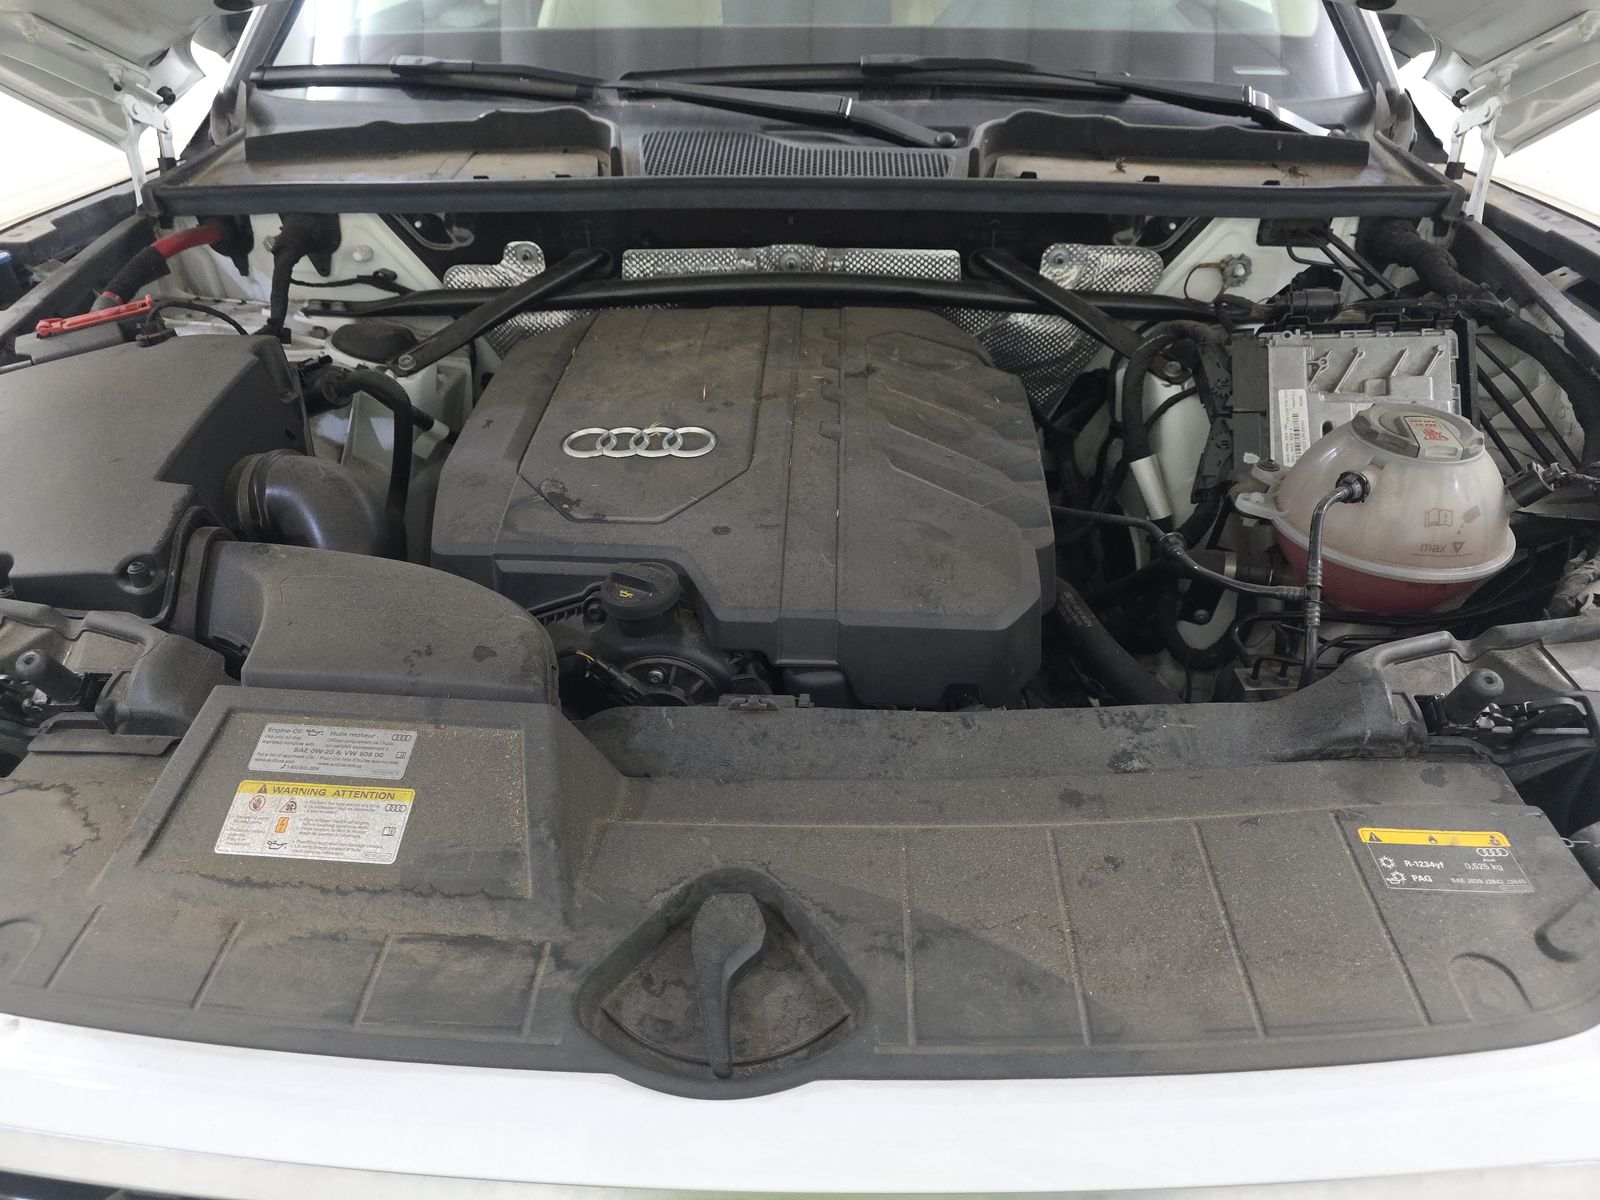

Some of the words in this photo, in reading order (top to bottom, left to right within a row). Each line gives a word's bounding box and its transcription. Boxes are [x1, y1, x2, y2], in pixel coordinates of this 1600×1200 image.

[1420, 544, 1447, 552] max
[272, 786, 327, 796] WARNING
[333, 790, 395, 800] ATTENTION
